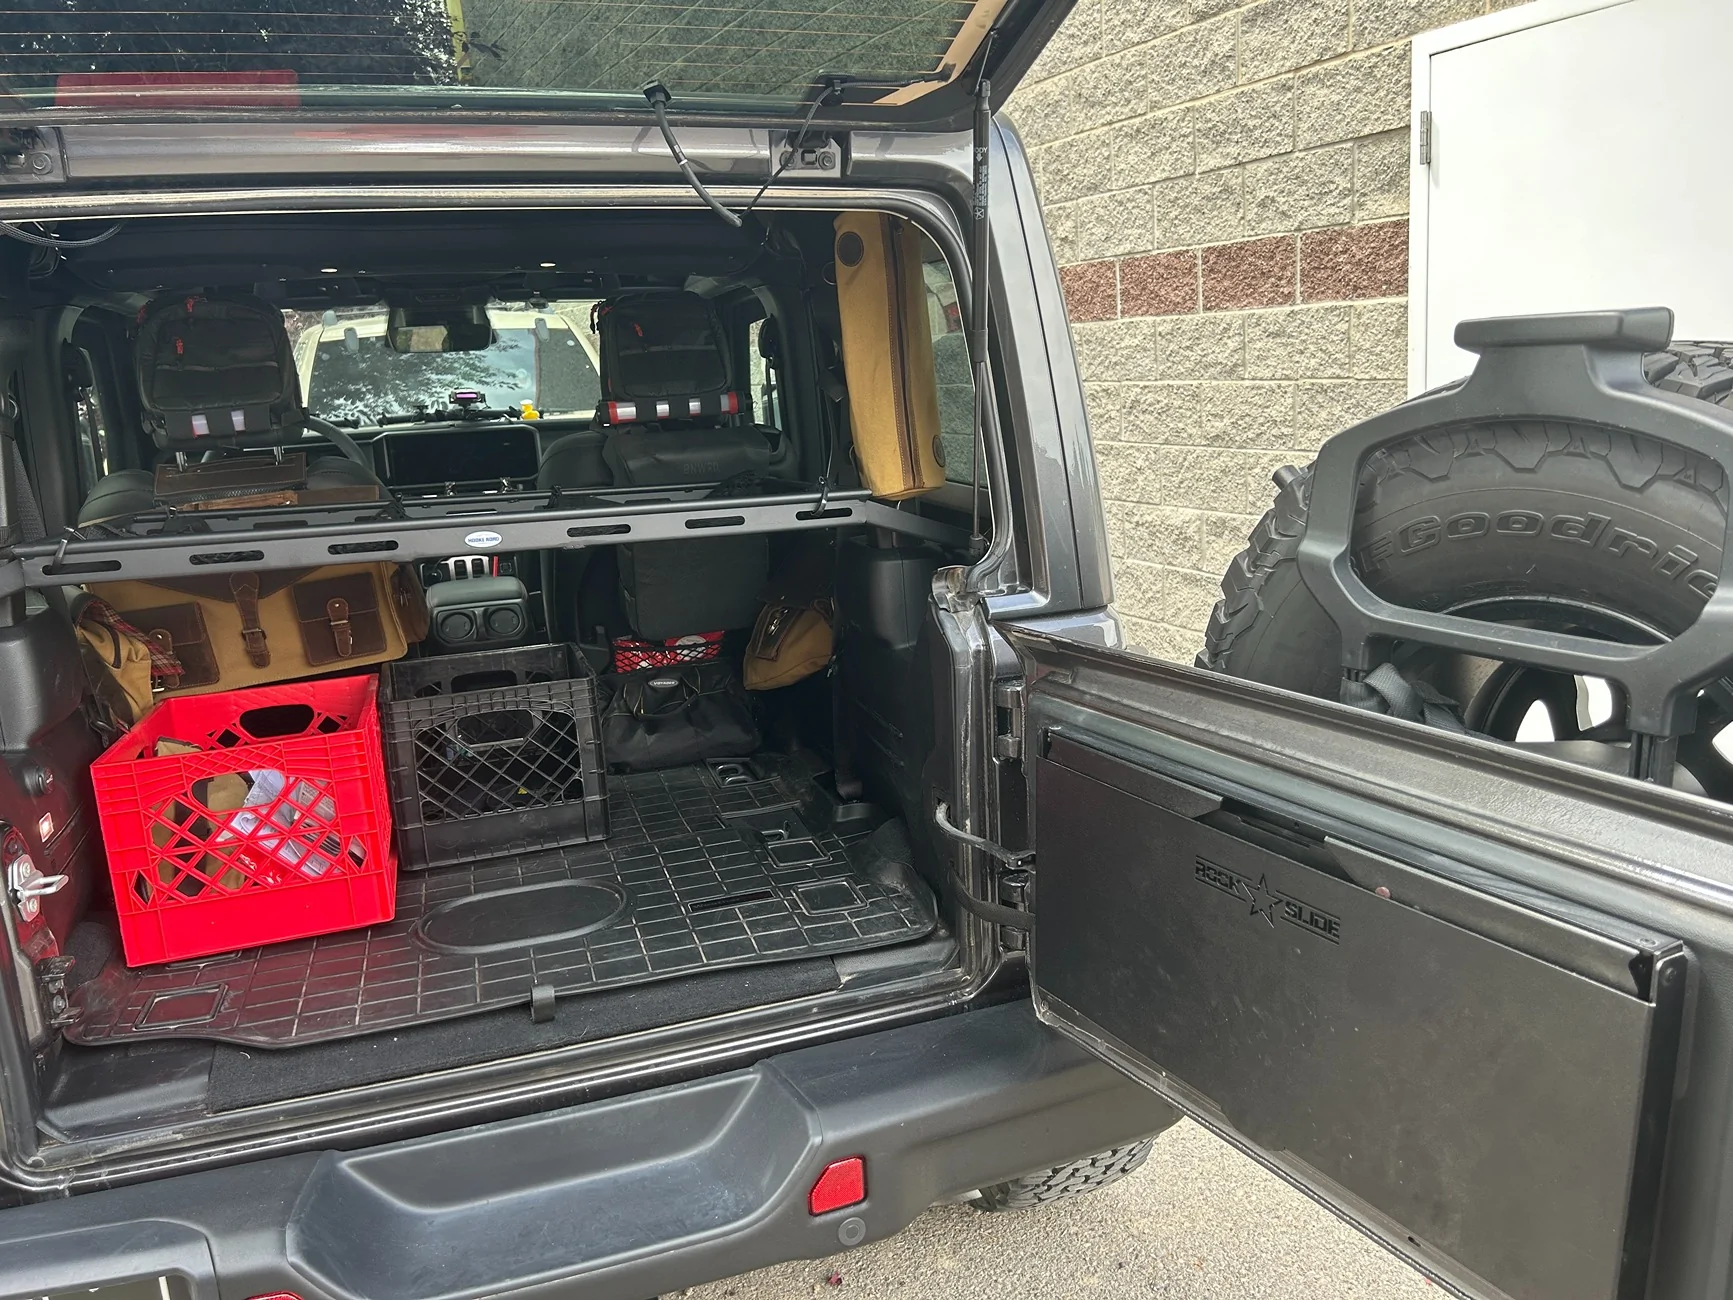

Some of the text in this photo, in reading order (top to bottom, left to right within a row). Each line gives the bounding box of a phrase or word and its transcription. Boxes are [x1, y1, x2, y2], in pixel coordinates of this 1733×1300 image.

[1349, 509, 1719, 601] FGoodric
[1195, 860, 1341, 939] ROCK SLIDE
